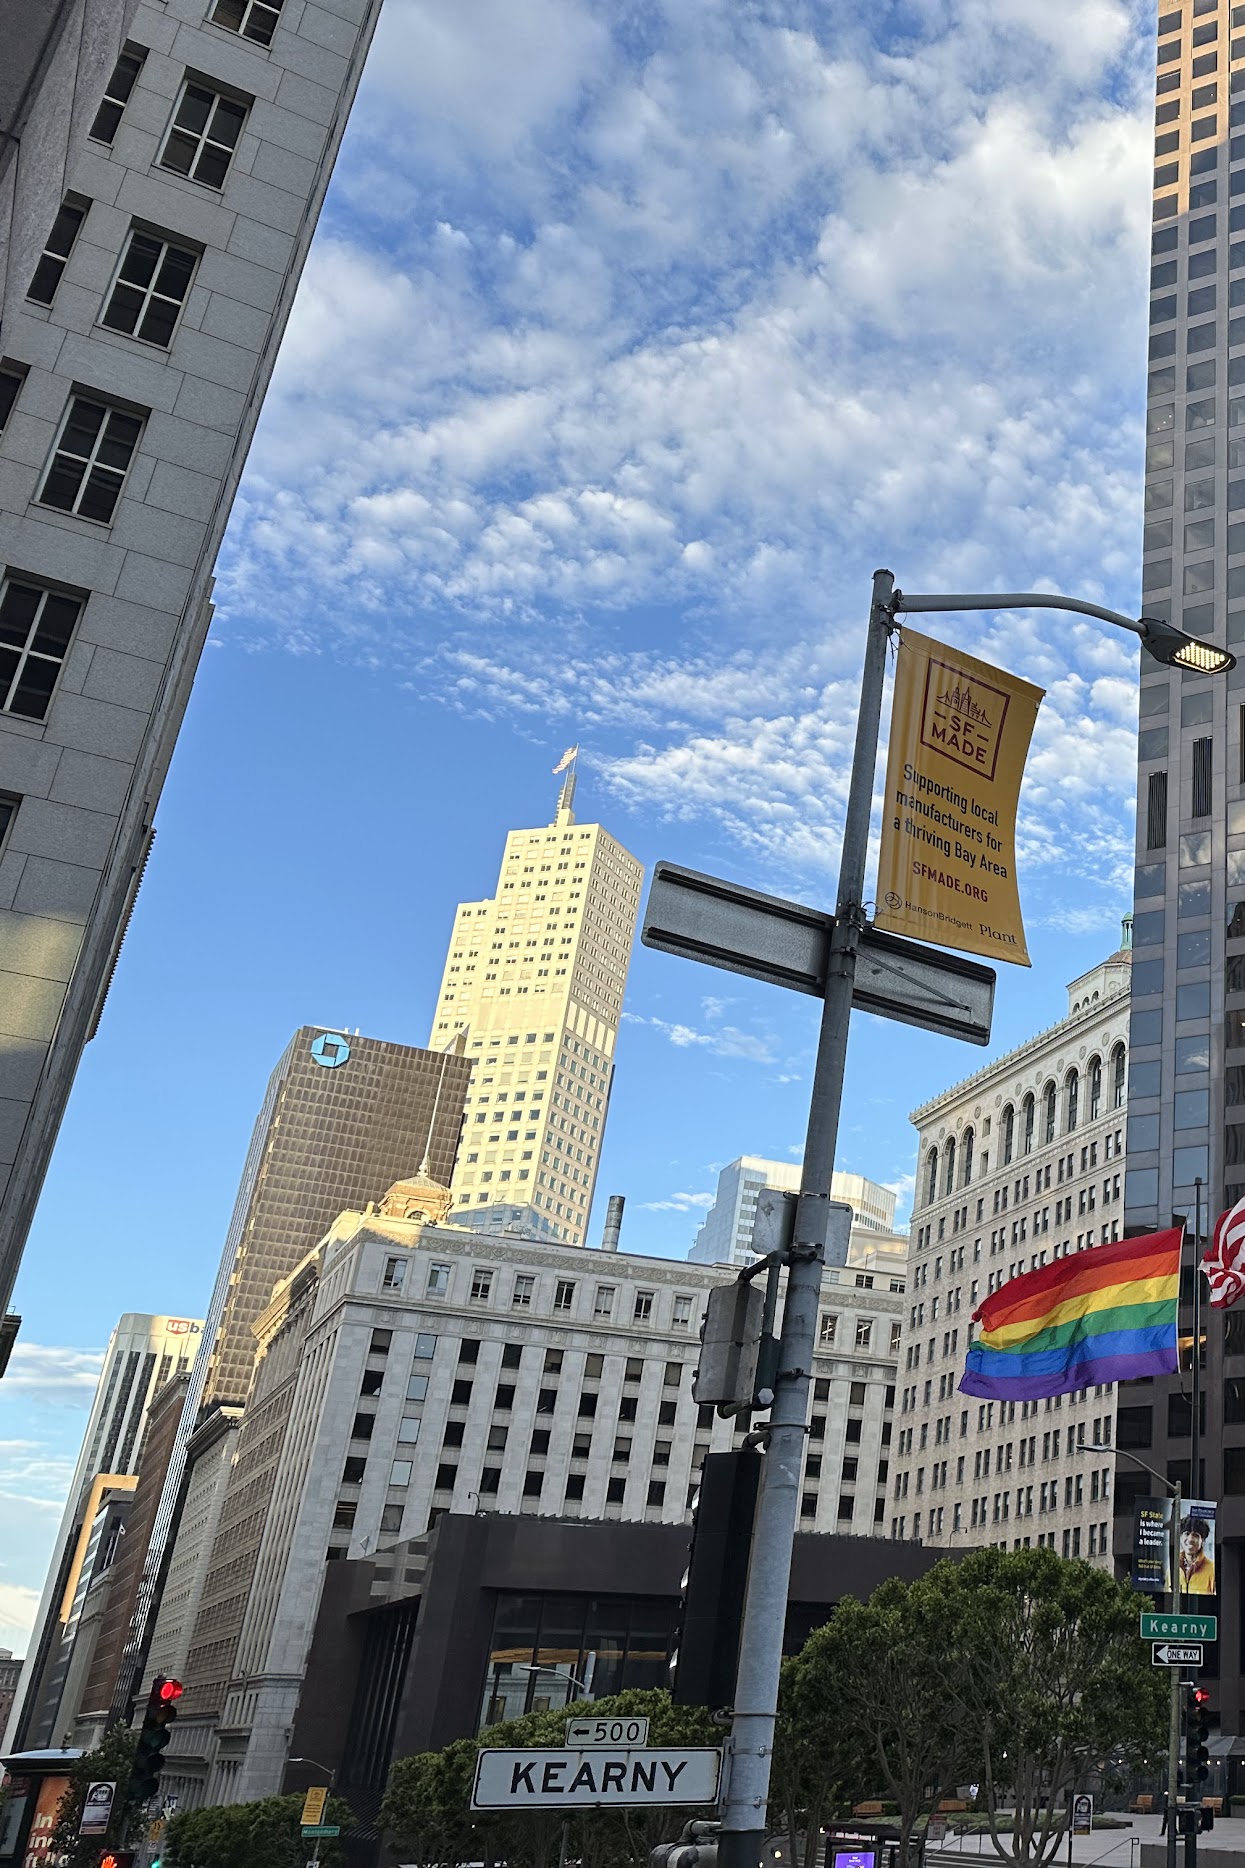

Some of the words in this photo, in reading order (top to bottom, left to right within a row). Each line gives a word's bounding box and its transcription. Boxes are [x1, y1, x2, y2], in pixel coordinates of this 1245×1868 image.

[949, 715, 975, 736] SF
[932, 722, 987, 764] MADE
[903, 764, 968, 814] Supporting
[971, 798, 999, 827] local
[896, 790, 983, 844] manufacturers
[986, 832, 1003, 852] for
[893, 816, 901, 831] a
[904, 818, 951, 858] thriving
[954, 841, 976, 868] Bay
[980, 854, 1008, 878] Area
[912, 861, 988, 902] SFMADE.ORG
[905, 900, 973, 931] HansonBridgett
[979, 923, 1018, 945] Plant
[1140, 1510, 1148, 1518] SF
[1149, 1511, 1164, 1519] State
[1146, 1520, 1164, 1528] where
[1150, 1619, 1207, 1637] Kearny
[1167, 1650, 1181, 1659] ONE
[1183, 1650, 1198, 1660] WAY
[594, 1722, 640, 1742] 500
[510, 1761, 688, 1793] KEARNY
[34, 1812, 54, 1828] In
